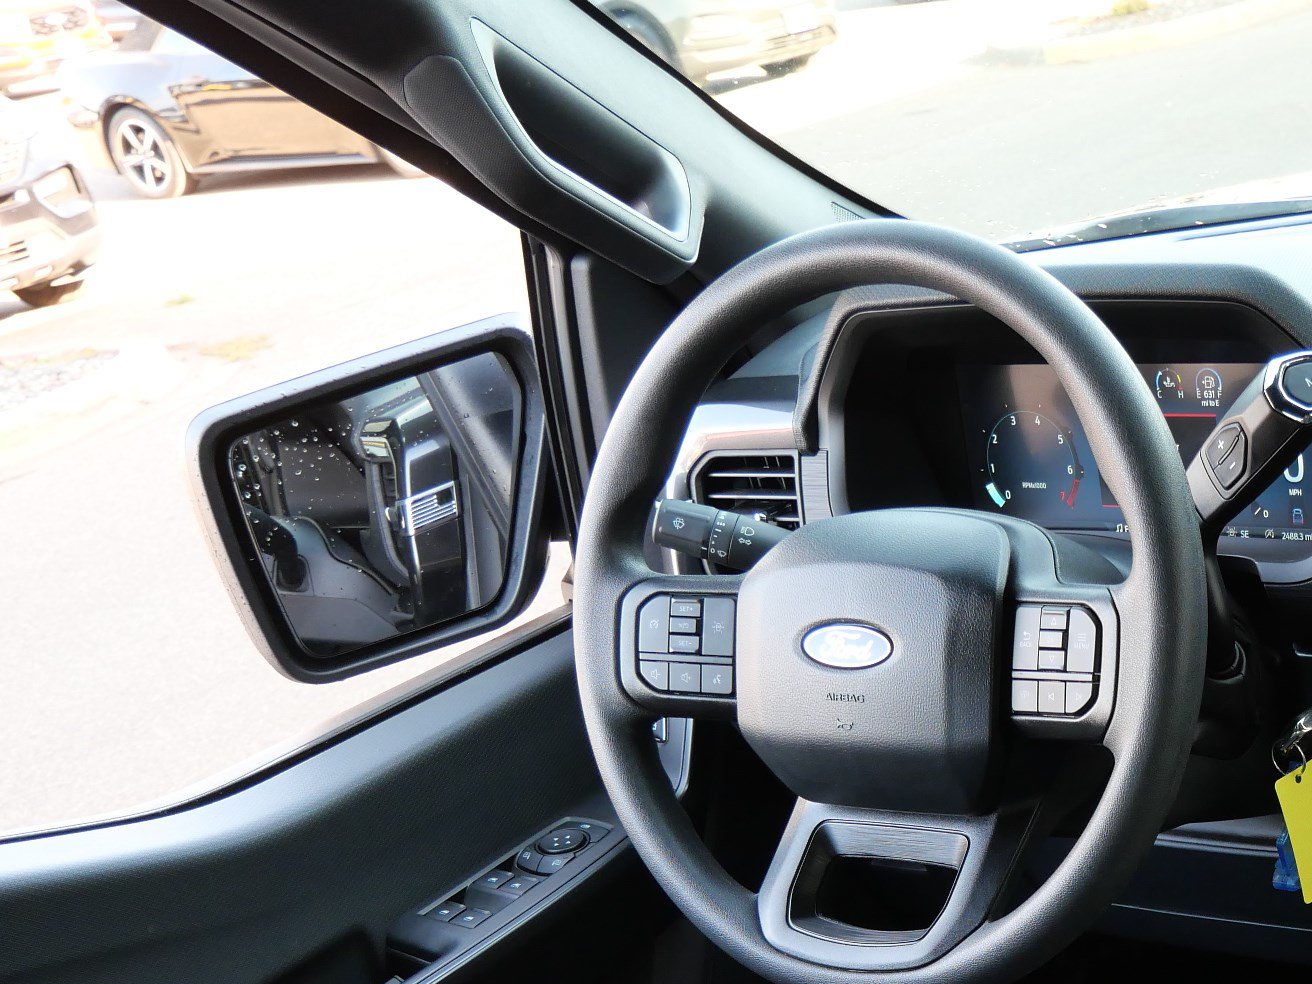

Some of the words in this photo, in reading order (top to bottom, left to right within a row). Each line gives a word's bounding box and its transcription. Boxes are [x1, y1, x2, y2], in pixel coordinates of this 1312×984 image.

[1203, 390, 1215, 399] 631
[1010, 415, 1017, 426] 3
[1034, 415, 1041, 426] 4
[992, 434, 998, 444] 2
[1057, 434, 1064, 445] 5
[990, 463, 995, 474] 1
[1067, 465, 1073, 475] 6
[1005, 489, 1011, 500] 0
[1288, 488, 1302, 497] MPH
[1263, 510, 1269, 519] 0
[1240, 529, 1250, 539] SE
[819, 630, 875, 661] Ford
[826, 692, 866, 704] AIRBAG
